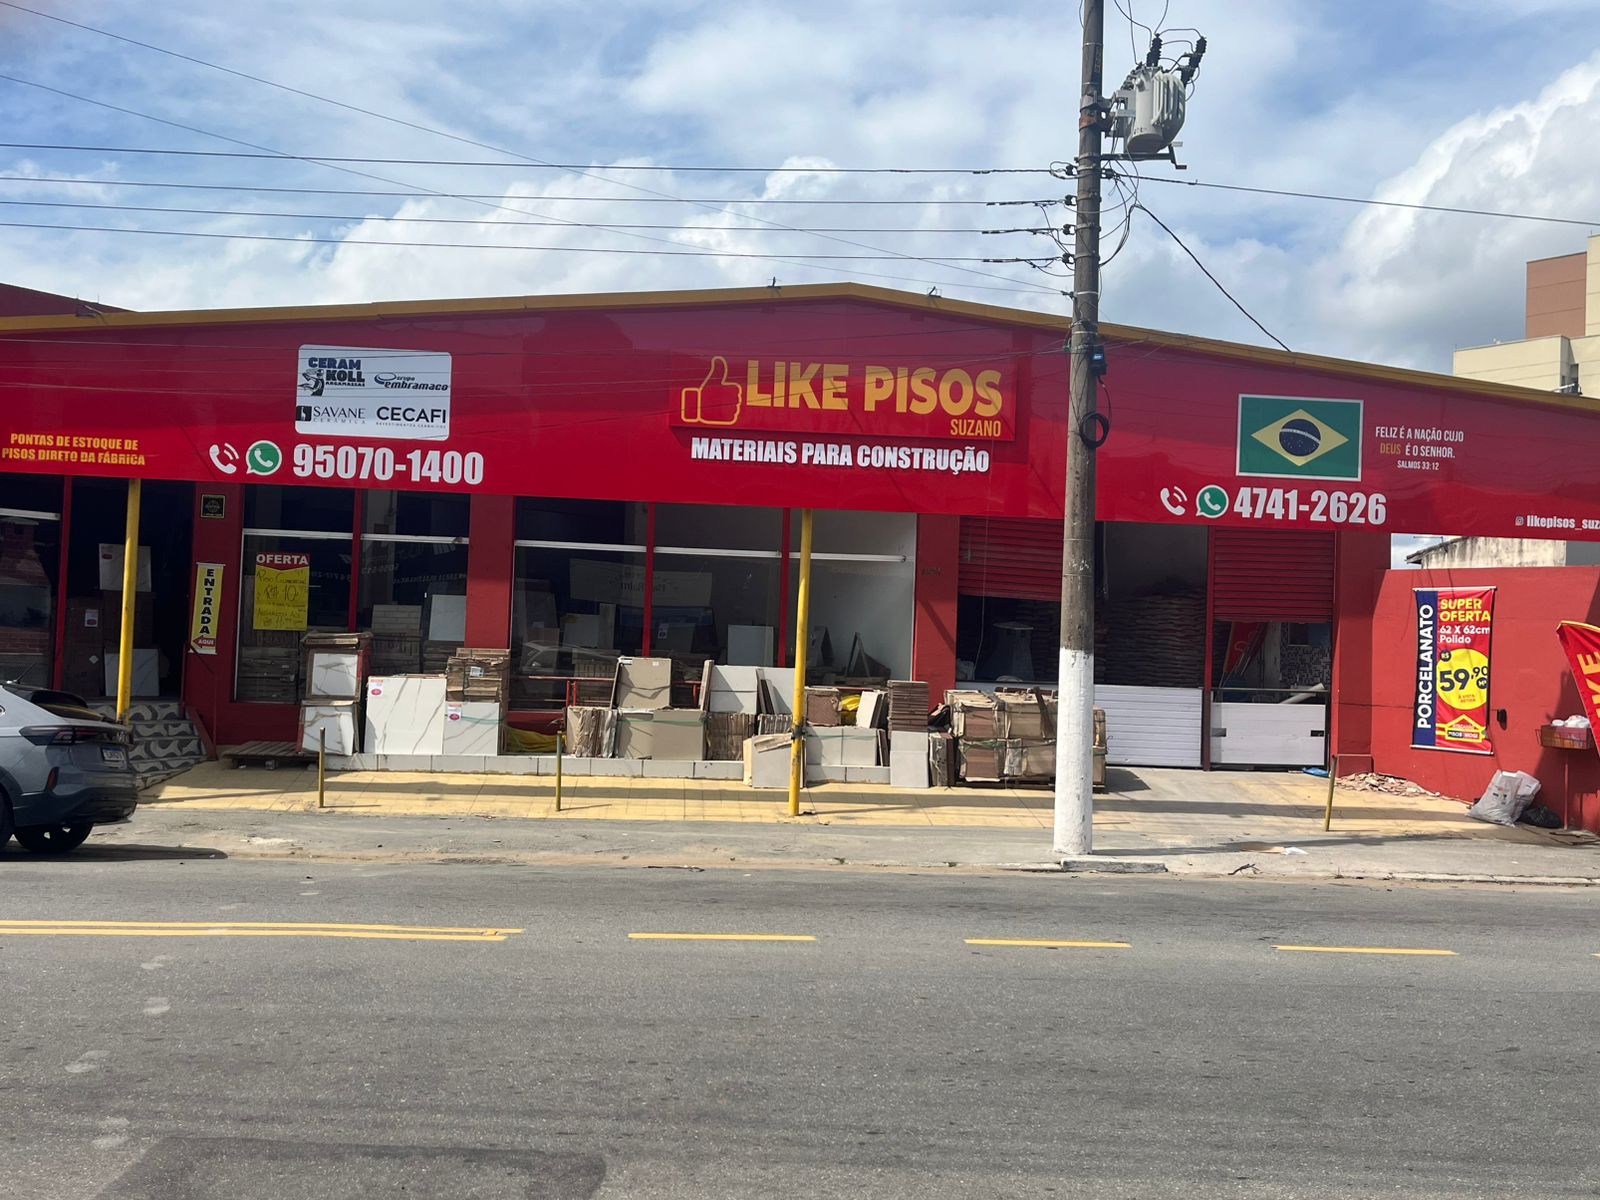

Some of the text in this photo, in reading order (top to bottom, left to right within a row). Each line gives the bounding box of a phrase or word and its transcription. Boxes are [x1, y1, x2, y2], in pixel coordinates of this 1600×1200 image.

[309, 357, 361, 370] CERAM
[325, 369, 366, 382] KOLL
[384, 380, 449, 391] embramaco
[746, 359, 1003, 417] LIKE PISOS
[313, 405, 367, 420] SAVANE
[376, 406, 447, 424] CECAFI
[950, 418, 1001, 438] SUZANO
[1375, 425, 1464, 442] FELIZ É A NAÇÃO CUJO
[10, 433, 139, 451] PONTAS DE ESTOQUE DE
[1380, 442, 1456, 459] DEUS É O SENHOR.
[1, 447, 146, 466] PISOS DIRETO DA FÁBRICA
[292, 443, 485, 485] 95070-1400
[691, 436, 990, 475] MATERIAIS PARA CONSTRUÇÃO
[1397, 460, 1440, 471] SALMOS 33:12
[1233, 486, 1387, 526] 4741-2626
[1526, 514, 1600, 531] likepisos_suz
[256, 554, 309, 565] OFERTA
[199, 568, 215, 635] ENTRADA
[1440, 597, 1482, 610] SUPER
[1440, 610, 1491, 622] OFERTA
[1440, 624, 1490, 635] 62 X 62cm
[198, 638, 214, 646] AQUI
[1440, 635, 1472, 644] Polido
[1417, 604, 1434, 729] PORCELANATO
[1440, 665, 1489, 692] 59,90
